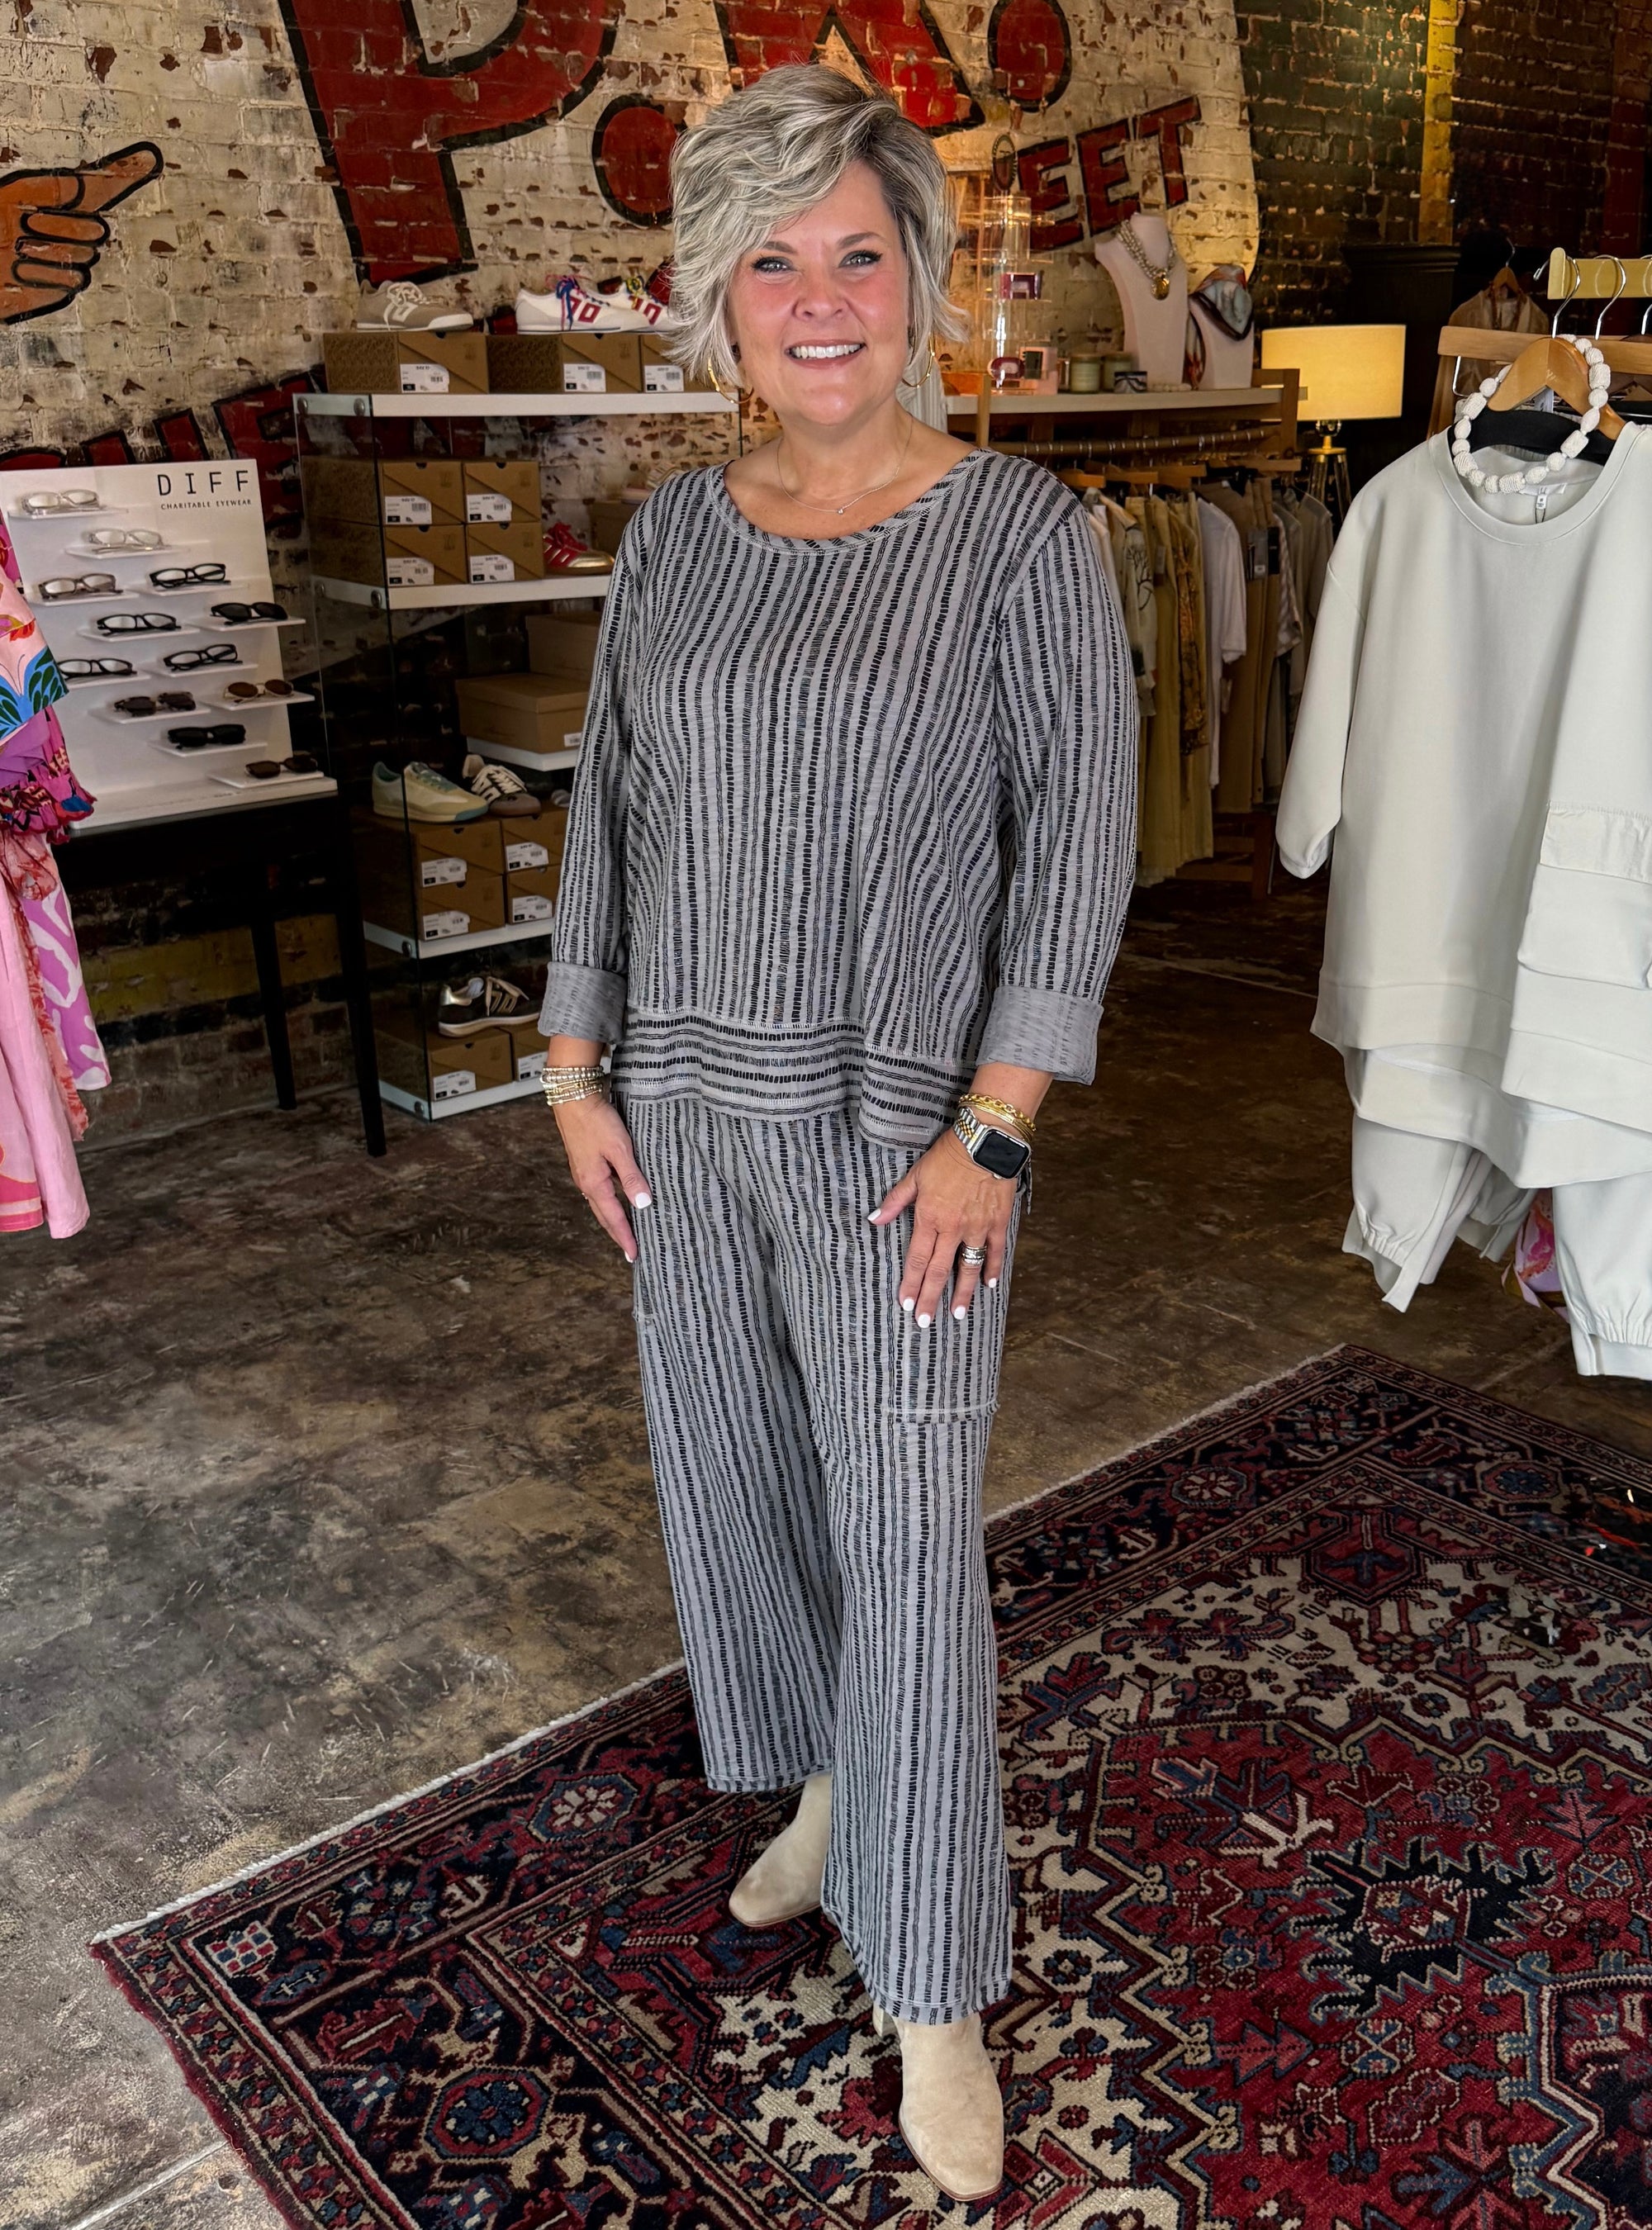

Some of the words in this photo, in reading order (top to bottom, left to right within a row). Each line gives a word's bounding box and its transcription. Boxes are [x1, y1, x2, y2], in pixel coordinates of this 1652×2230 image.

[1003, 94, 1203, 254] EET
[157, 470, 249, 496] DIFF
[161, 501, 211, 510] CHARITABLE
[216, 499, 252, 507] EYEWEAR
